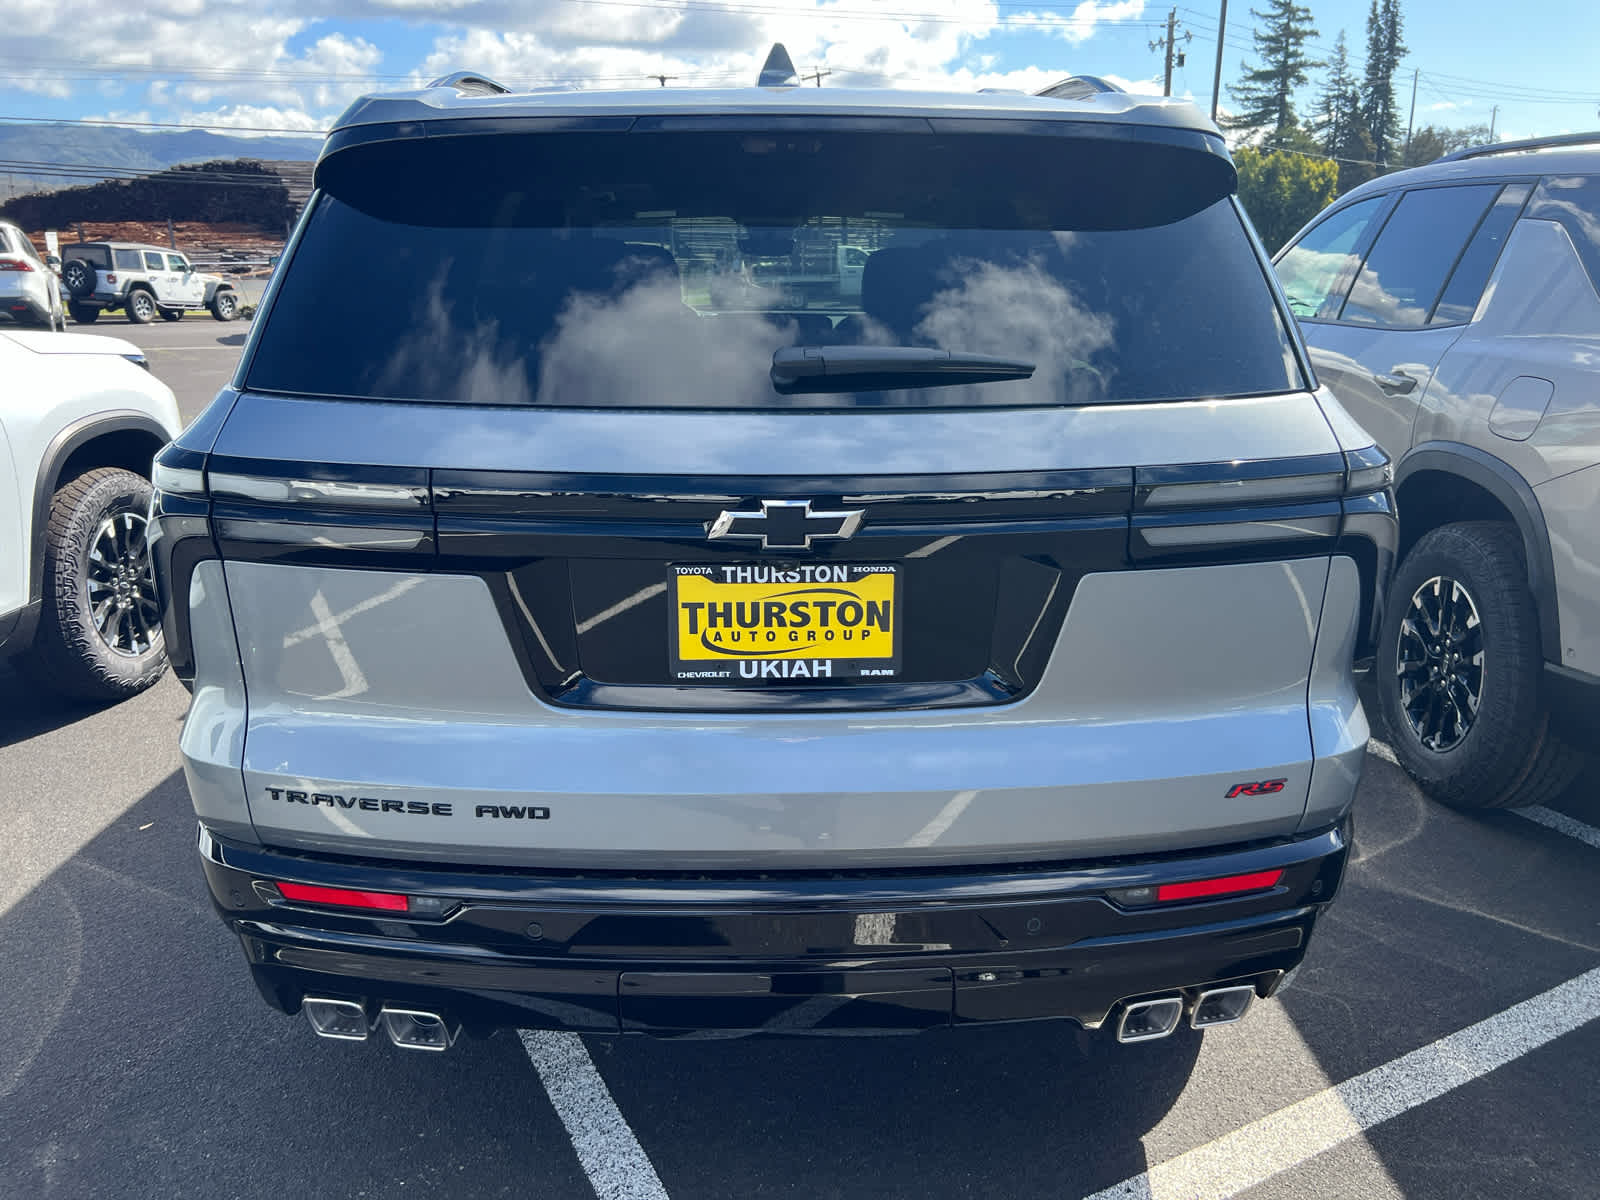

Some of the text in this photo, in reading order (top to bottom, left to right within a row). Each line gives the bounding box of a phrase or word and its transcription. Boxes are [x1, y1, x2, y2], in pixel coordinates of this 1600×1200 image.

[675, 567, 713, 575] TOYOTA
[721, 565, 848, 583] THURSTON
[681, 599, 891, 635] THURSTON
[713, 630, 871, 642] AUTO GROUP
[678, 671, 731, 679] CHEVROLET
[739, 660, 832, 678] UKIAH
[1224, 778, 1288, 798] RS
[265, 787, 550, 819] TRAVERSE AWD
